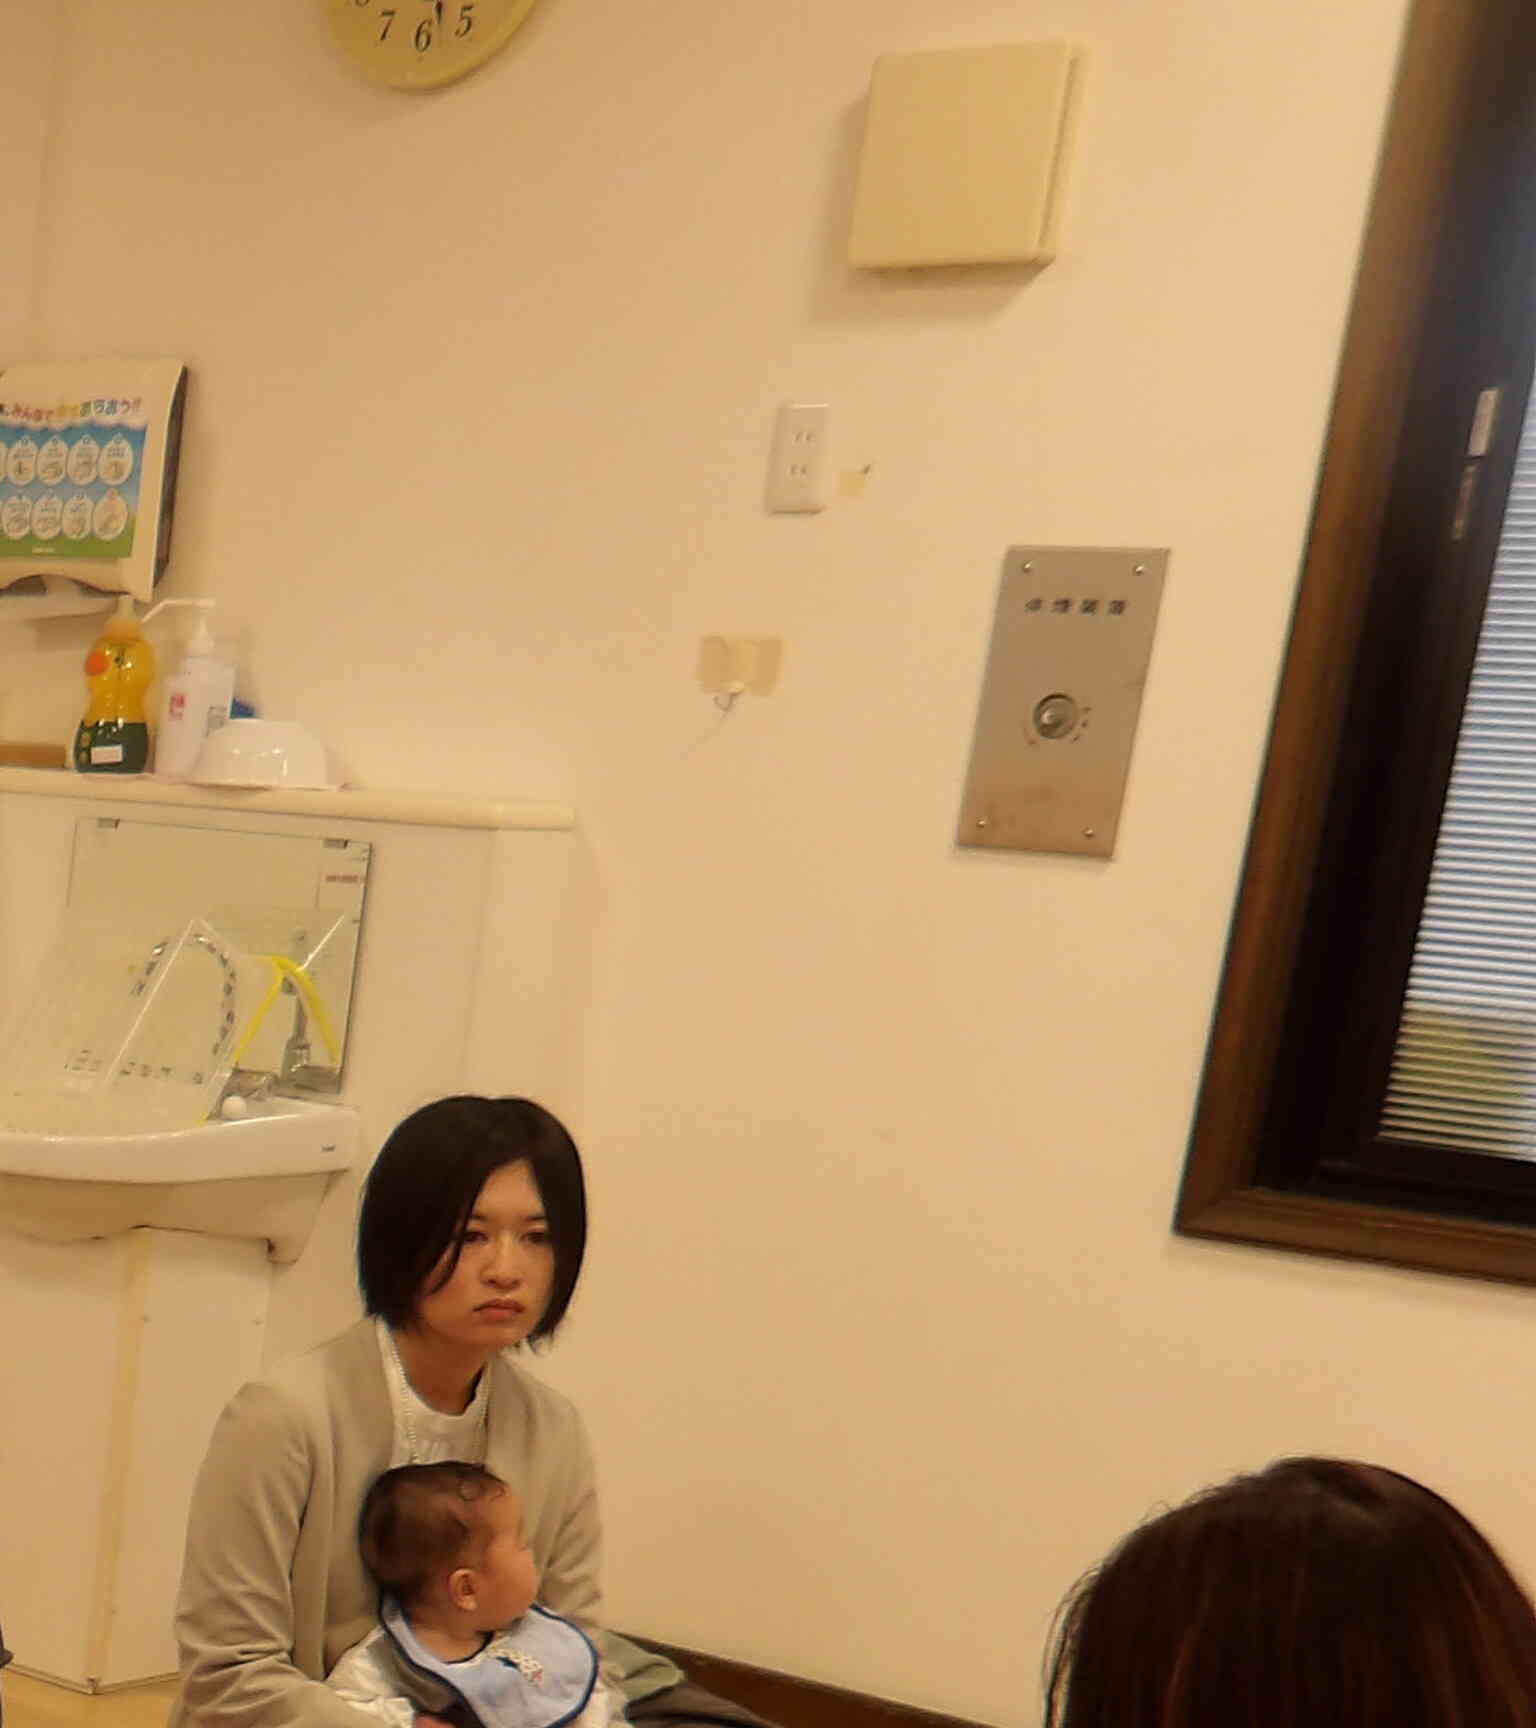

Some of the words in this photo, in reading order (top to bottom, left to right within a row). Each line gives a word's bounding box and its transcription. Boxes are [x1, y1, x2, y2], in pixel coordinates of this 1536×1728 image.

[379, 10, 396, 41] 7
[415, 19, 432, 51] 6
[454, 5, 474, 38] 5
